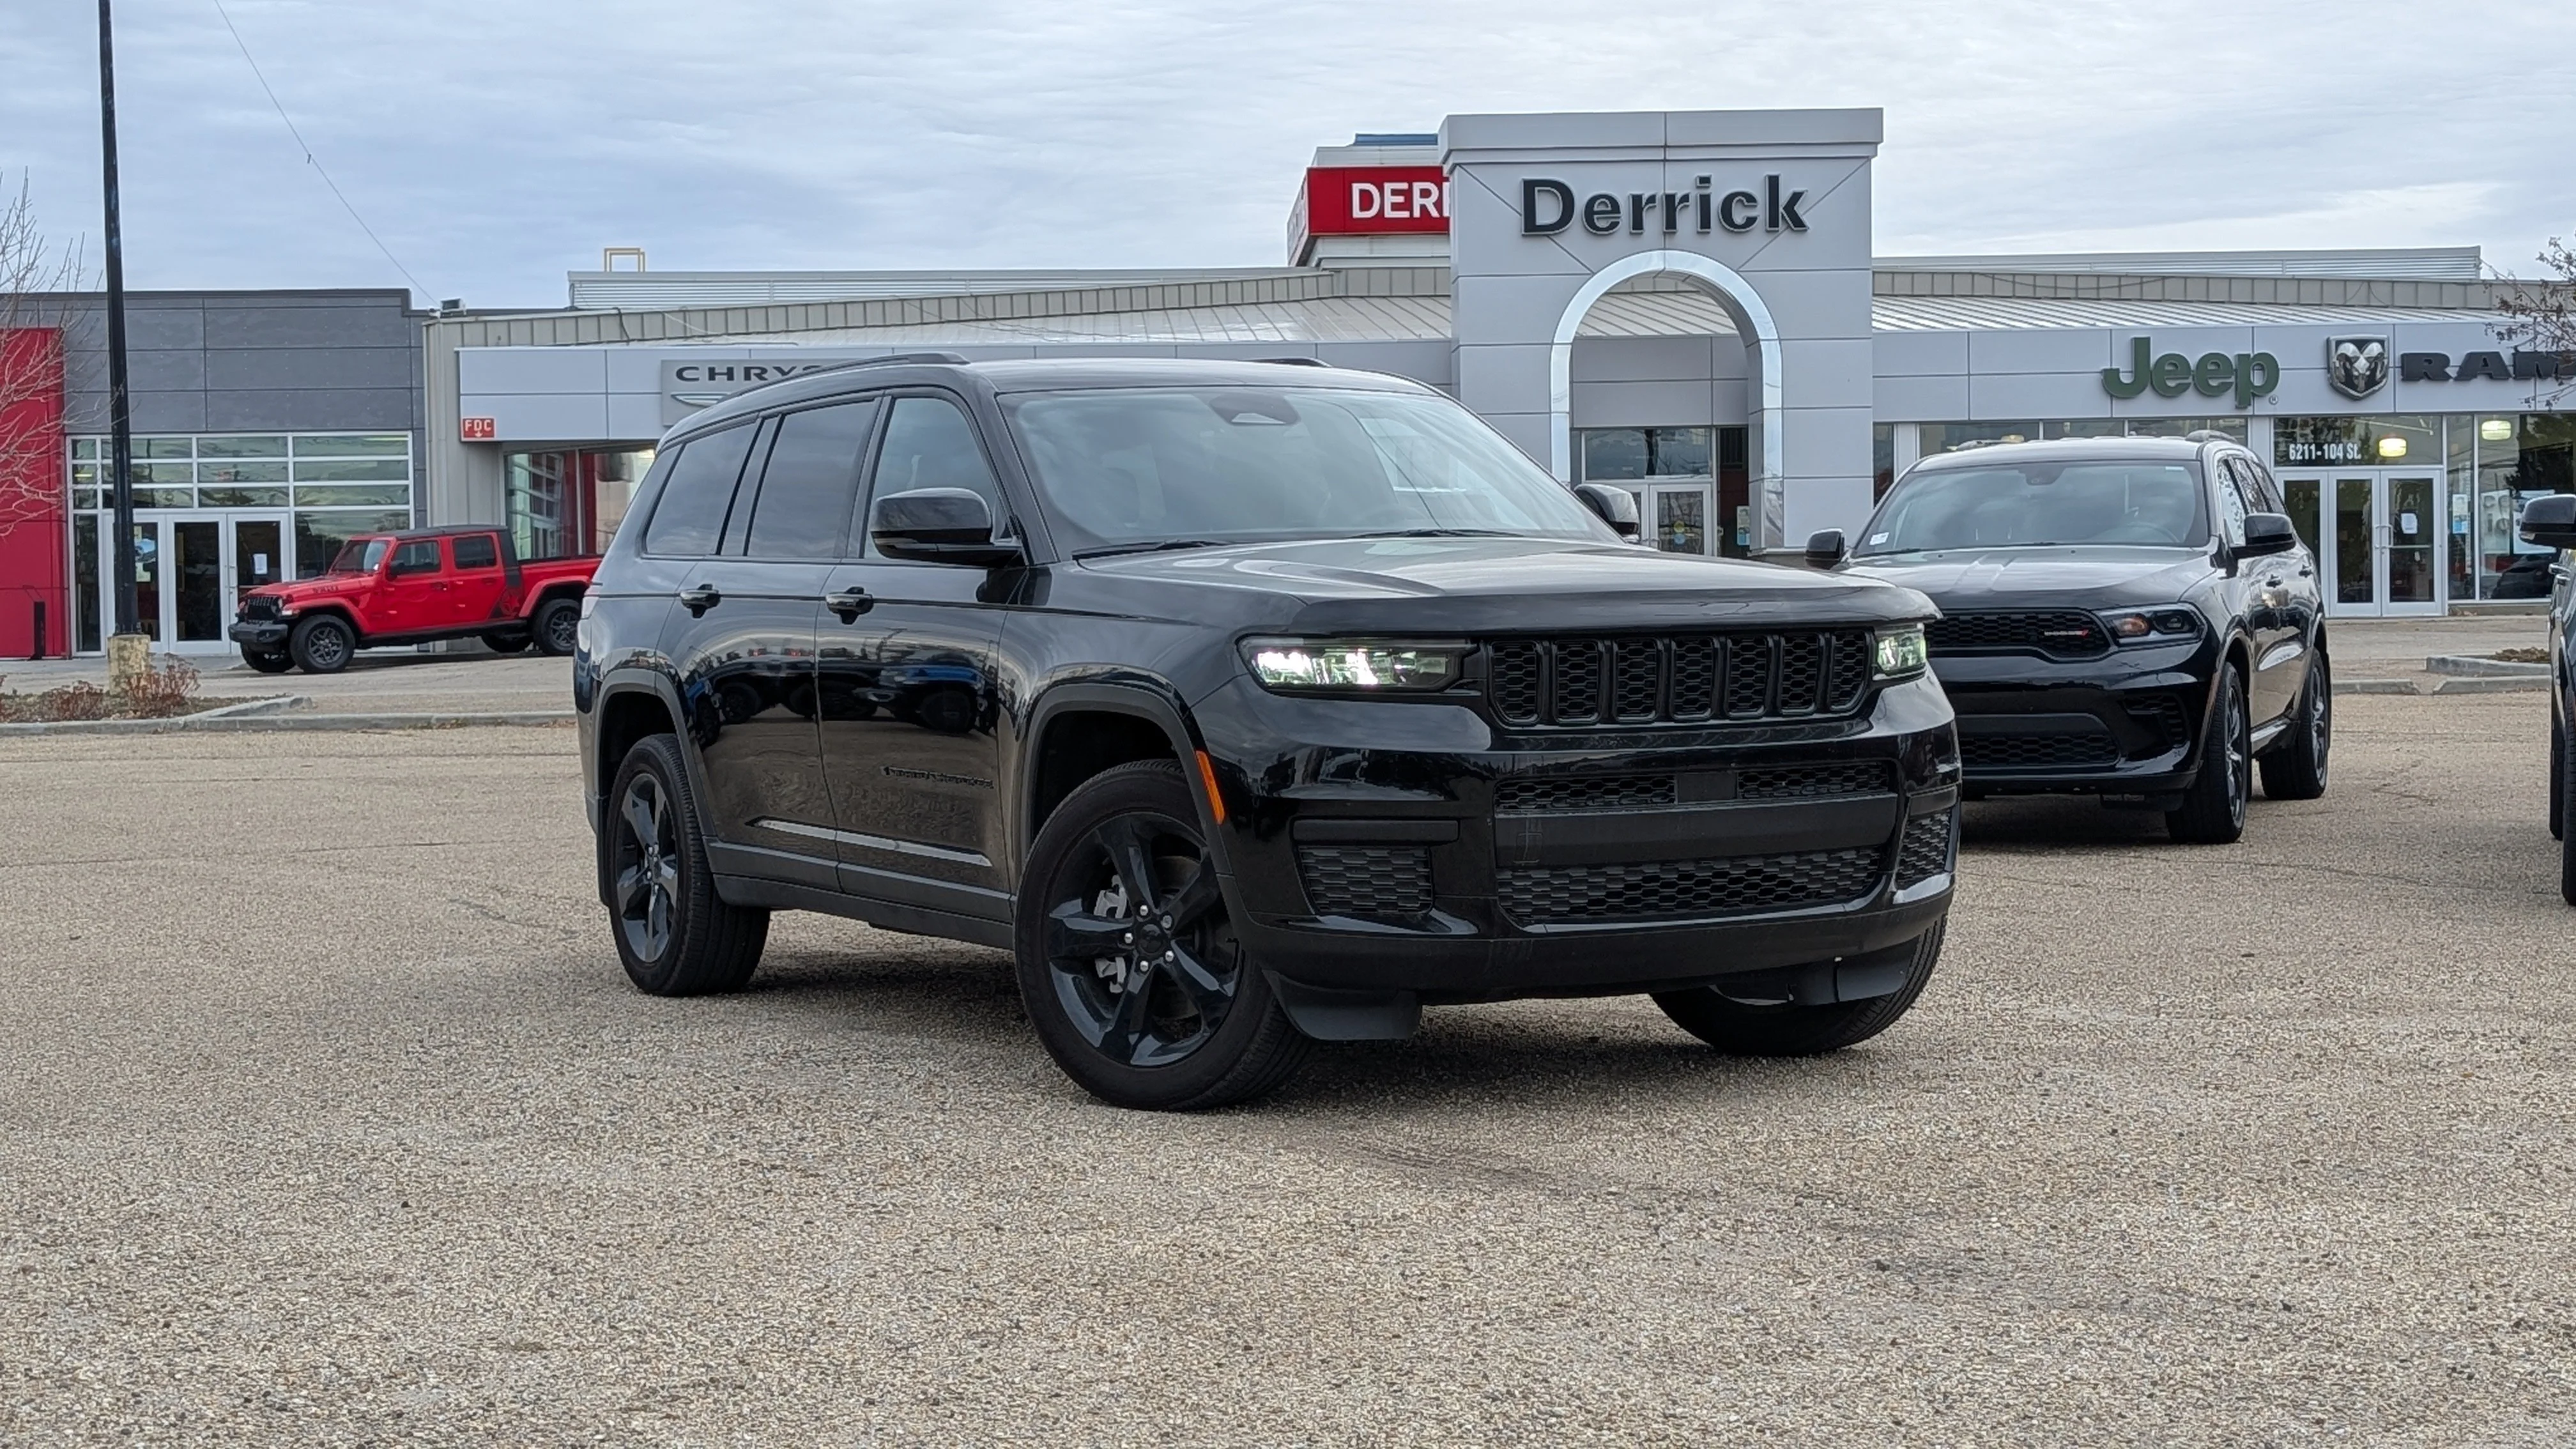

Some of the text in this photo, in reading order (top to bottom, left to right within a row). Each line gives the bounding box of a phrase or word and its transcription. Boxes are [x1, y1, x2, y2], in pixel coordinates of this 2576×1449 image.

[1351, 181, 1450, 219] DER
[1521, 172, 1809, 235] Derrick
[2101, 336, 2280, 409] Jeep
[2400, 351, 2576, 381] RAM
[465, 419, 491, 431] FDC
[2289, 443, 2343, 460] 6211-104
